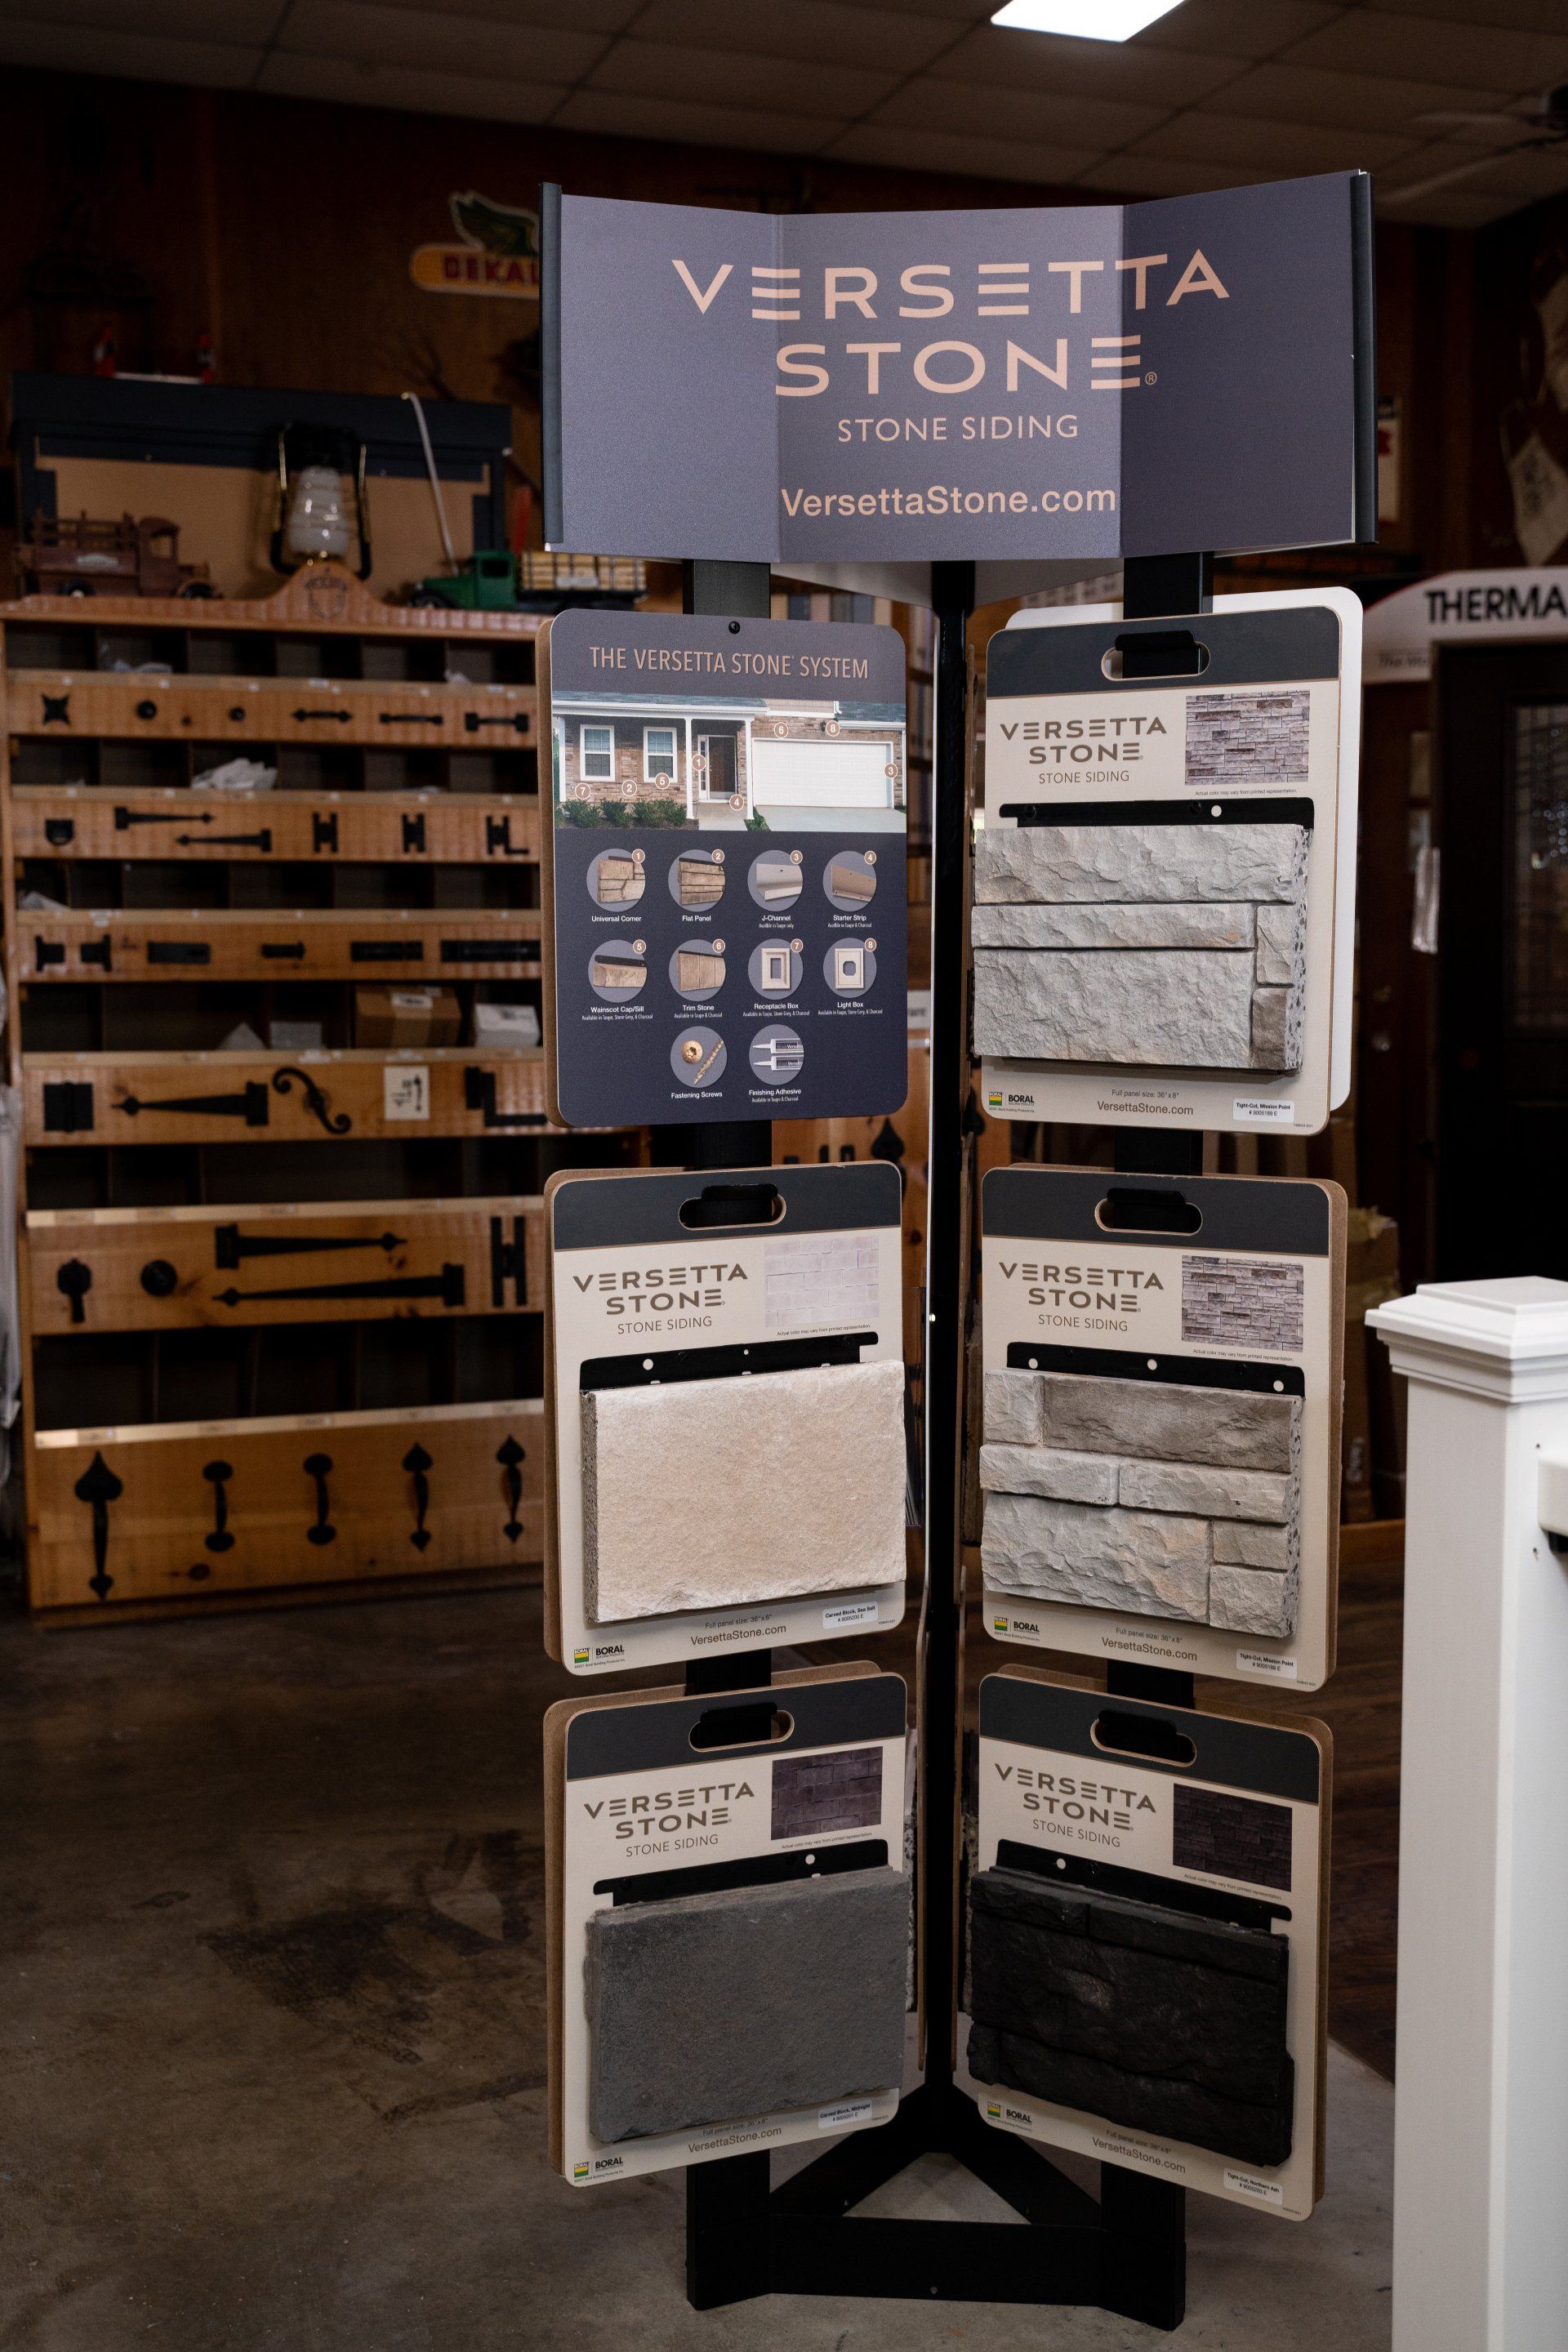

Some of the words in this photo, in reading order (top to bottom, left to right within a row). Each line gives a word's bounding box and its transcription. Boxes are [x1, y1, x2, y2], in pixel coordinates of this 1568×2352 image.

[671, 249, 1231, 321] VERSETTA
[837, 416, 948, 443] STONE
[962, 414, 1079, 441] SIDING
[781, 483, 1116, 517] VersettaStone.com
[590, 646, 626, 669] THE
[634, 648, 726, 674] VERSETTA
[800, 656, 869, 679] SYSTEM
[1000, 715, 1166, 741] VERSETTA
[1039, 771, 1081, 785] STONE
[1086, 769, 1129, 783] SIDING
[621, 1006, 644, 1014] Cap/Sill
[671, 1091, 699, 1099] Fastening
[1008, 1094, 1034, 1102] BORAL
[1124, 1090, 1140, 1098] panel
[1097, 1100, 1194, 1116] VersettaStone.com
[572, 1263, 748, 1292] VERSETTA
[998, 1261, 1165, 1290] VERSETTA
[617, 1320, 662, 1334] STONE
[667, 1316, 712, 1331] SIDING
[1038, 1313, 1081, 1329] STONE
[1085, 1316, 1129, 1332] SIDING
[717, 1619, 733, 1628] panel
[735, 1617, 748, 1626] size:
[1013, 1620, 1039, 1632] BORAL
[691, 1625, 786, 1646] VersettaStone.com
[1128, 1629, 1144, 1638] panel
[596, 1645, 624, 1656] BORAL
[1102, 1637, 1197, 1661] VersettaStone.com
[994, 1762, 1156, 1814] VERSETTA
[583, 1781, 755, 1820] VERSETTA
[1032, 1818, 1073, 1838] STONE
[1078, 1828, 1120, 1848] SIDING
[626, 1839, 670, 1857] STONE
[675, 1833, 719, 1852] SIDING
[1006, 2109, 1032, 2123] BORAL
[688, 2127, 782, 2154] VersettaStone.com
[595, 2156, 624, 2169] BORAL
[1092, 2136, 1186, 2173] VersettaStone.com
